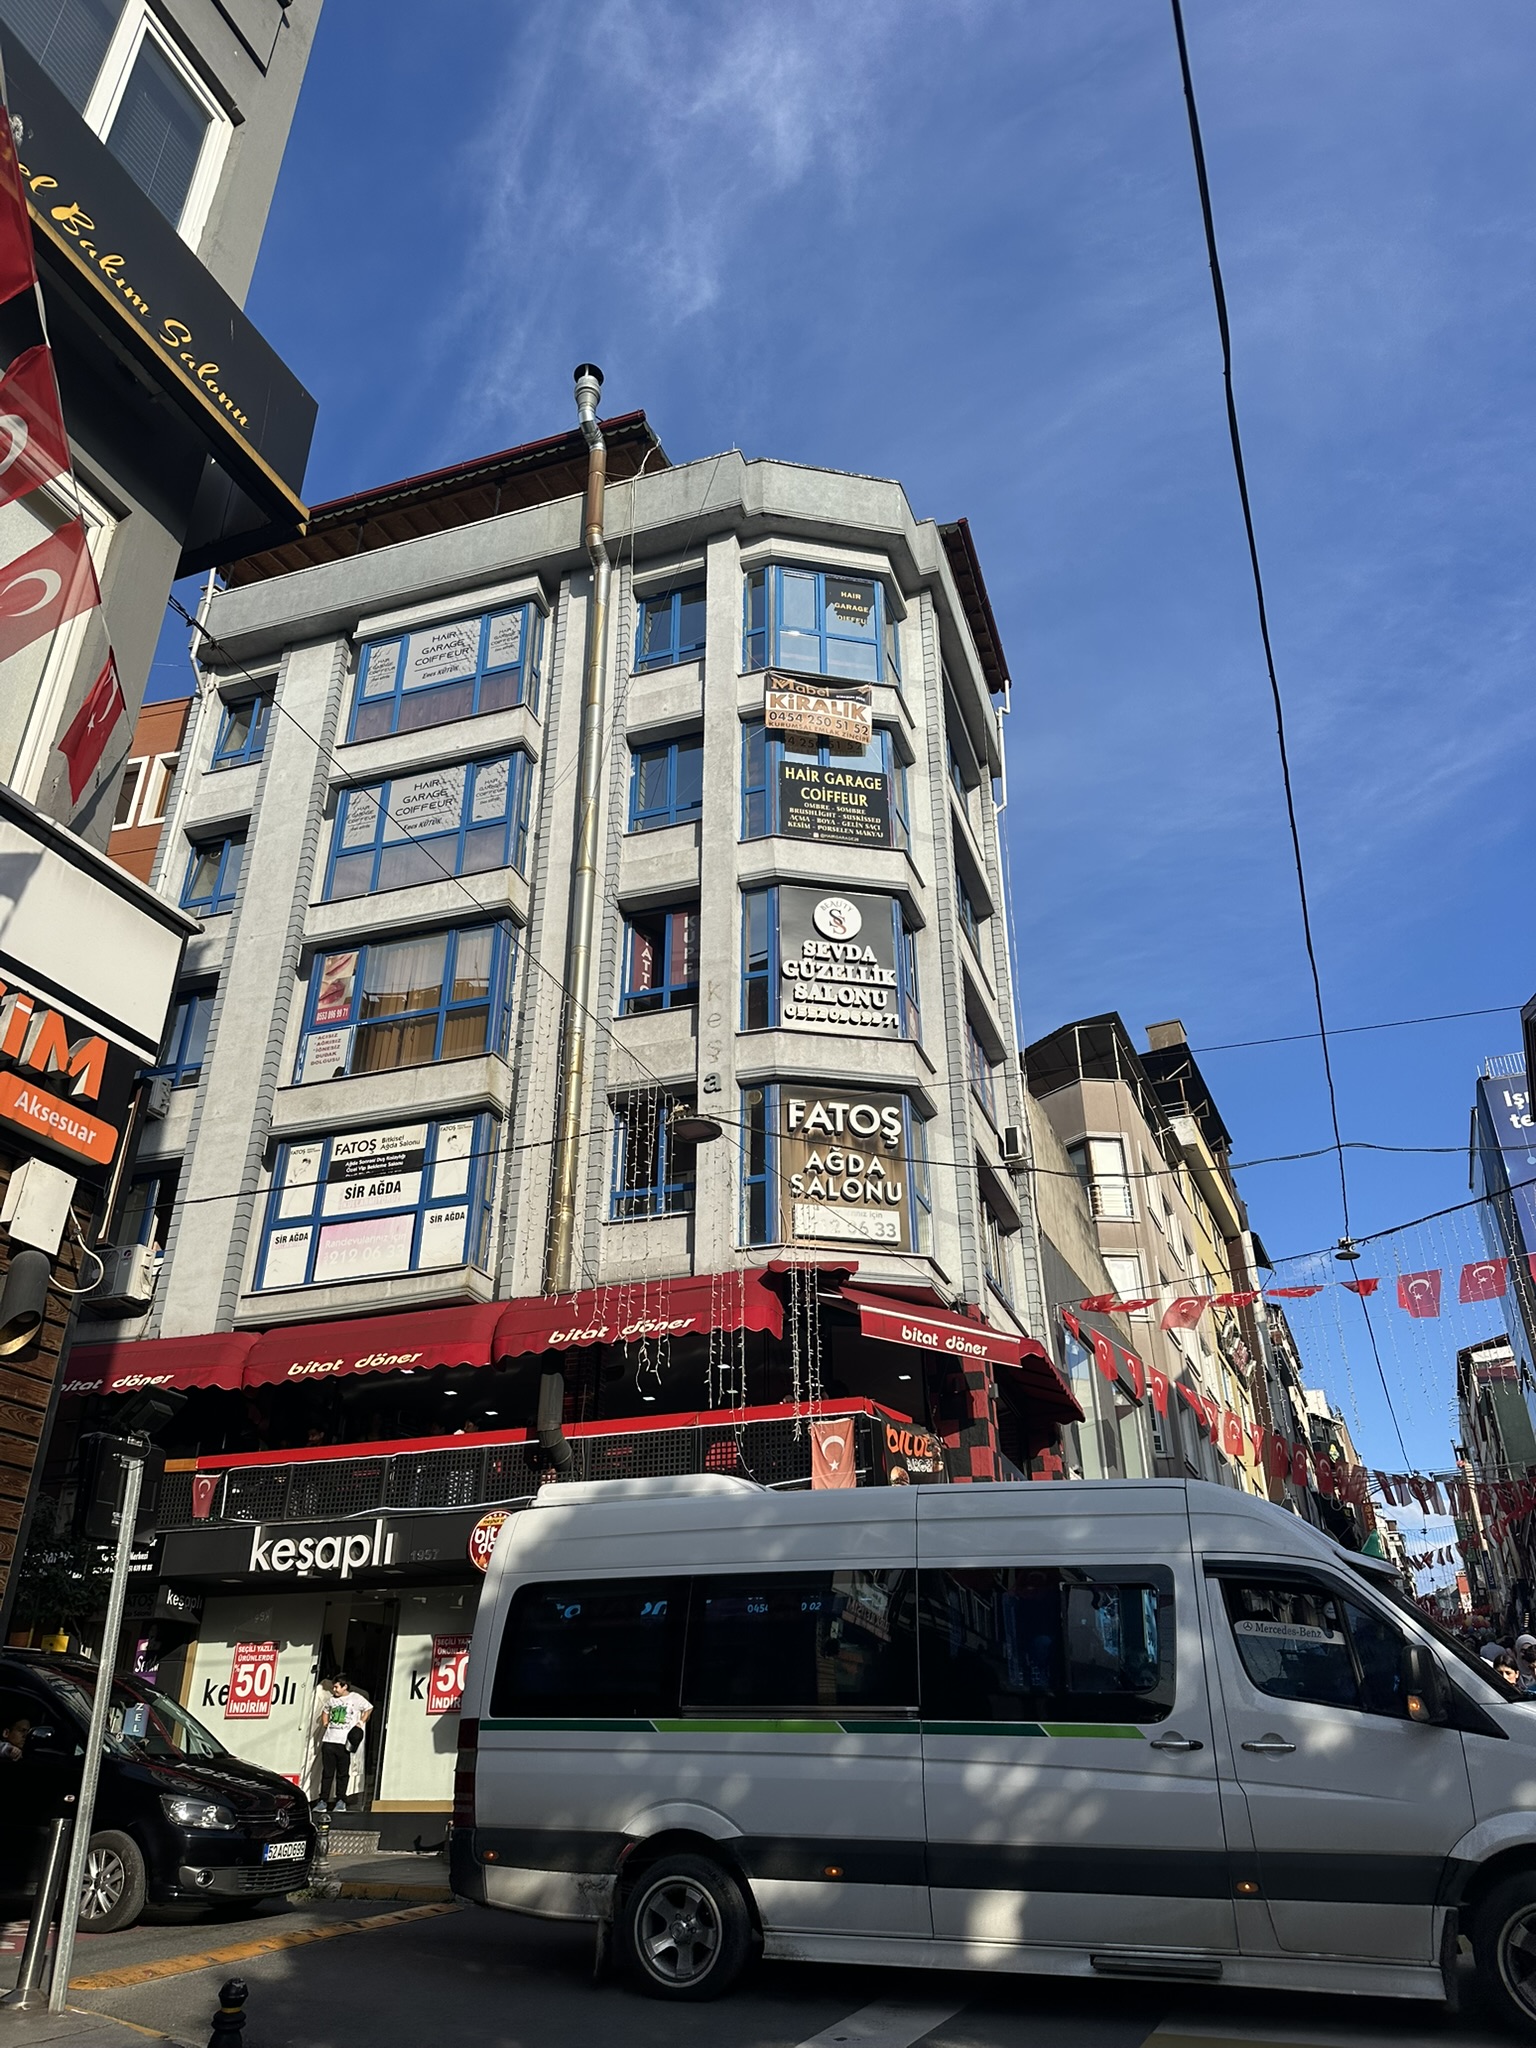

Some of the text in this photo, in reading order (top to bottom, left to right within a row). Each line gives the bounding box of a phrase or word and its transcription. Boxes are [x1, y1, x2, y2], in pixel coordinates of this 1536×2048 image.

[157, 317, 251, 430] Salonu
[840, 591, 862, 600] HAIR
[834, 602, 869, 613] GARAGE
[421, 638, 465, 655] GARAGE
[431, 630, 458, 644] HAIR
[414, 647, 470, 667] COIFFEUR
[771, 677, 830, 698] Mabel
[768, 721, 813, 731] KURUMSAL
[814, 726, 841, 737] EMLAK
[769, 711, 869, 736] 0454 250 51 52
[413, 779, 440, 791] HAIR
[784, 765, 883, 791] HAİR GARAGE
[402, 788, 449, 804] GARAGE
[800, 785, 869, 807] COİFFEUR
[395, 799, 454, 817] COIFFEUR
[803, 801, 867, 815] OMBRE SOMBRE
[787, 820, 884, 839] KESİM PORSELEN MAKYAJ
[789, 814, 811, 822] AÇMA
[816, 817, 836, 826] BOYA
[841, 819, 864, 829] GELİN
[820, 900, 854, 912] BEAUTY
[802, 939, 878, 964] SEVDA
[781, 957, 898, 987] GÜZELLİK
[793, 982, 889, 1008] SALONU
[14, 1090, 97, 1145] Aksesuar
[787, 1098, 902, 1145] FATOŞ
[335, 1138, 377, 1155] FATOŞ
[381, 1134, 405, 1144] Bitkisel
[380, 1139, 421, 1151] Ağda Salonu
[805, 1146, 887, 1178] AĞDA
[344, 1179, 402, 1200] SİR AĞDA
[790, 1173, 903, 1202] SALONU
[429, 1209, 465, 1224] SİR AĞDA
[275, 1231, 309, 1245] SİR AĞDA
[874, 1221, 897, 1238] 33
[549, 1317, 696, 1344] bitat döner
[901, 1325, 988, 1357] bitat döner
[288, 1350, 424, 1376] bitat döner
[112, 1373, 175, 1388] döner
[474, 1526, 499, 1545] bit
[249, 1518, 439, 1580] keşaplı 1957
[124, 1594, 155, 1610] ATOŞ
[1255, 1622, 1322, 1639] Mercedes-Benz
[237, 1645, 256, 1655] SEÇİLİ
[238, 1653, 275, 1662] ÜRÜNLERDE
[235, 1662, 273, 1698] 50
[229, 1698, 268, 1714] İNDİRİM
[133, 1702, 144, 1733] ZEL
